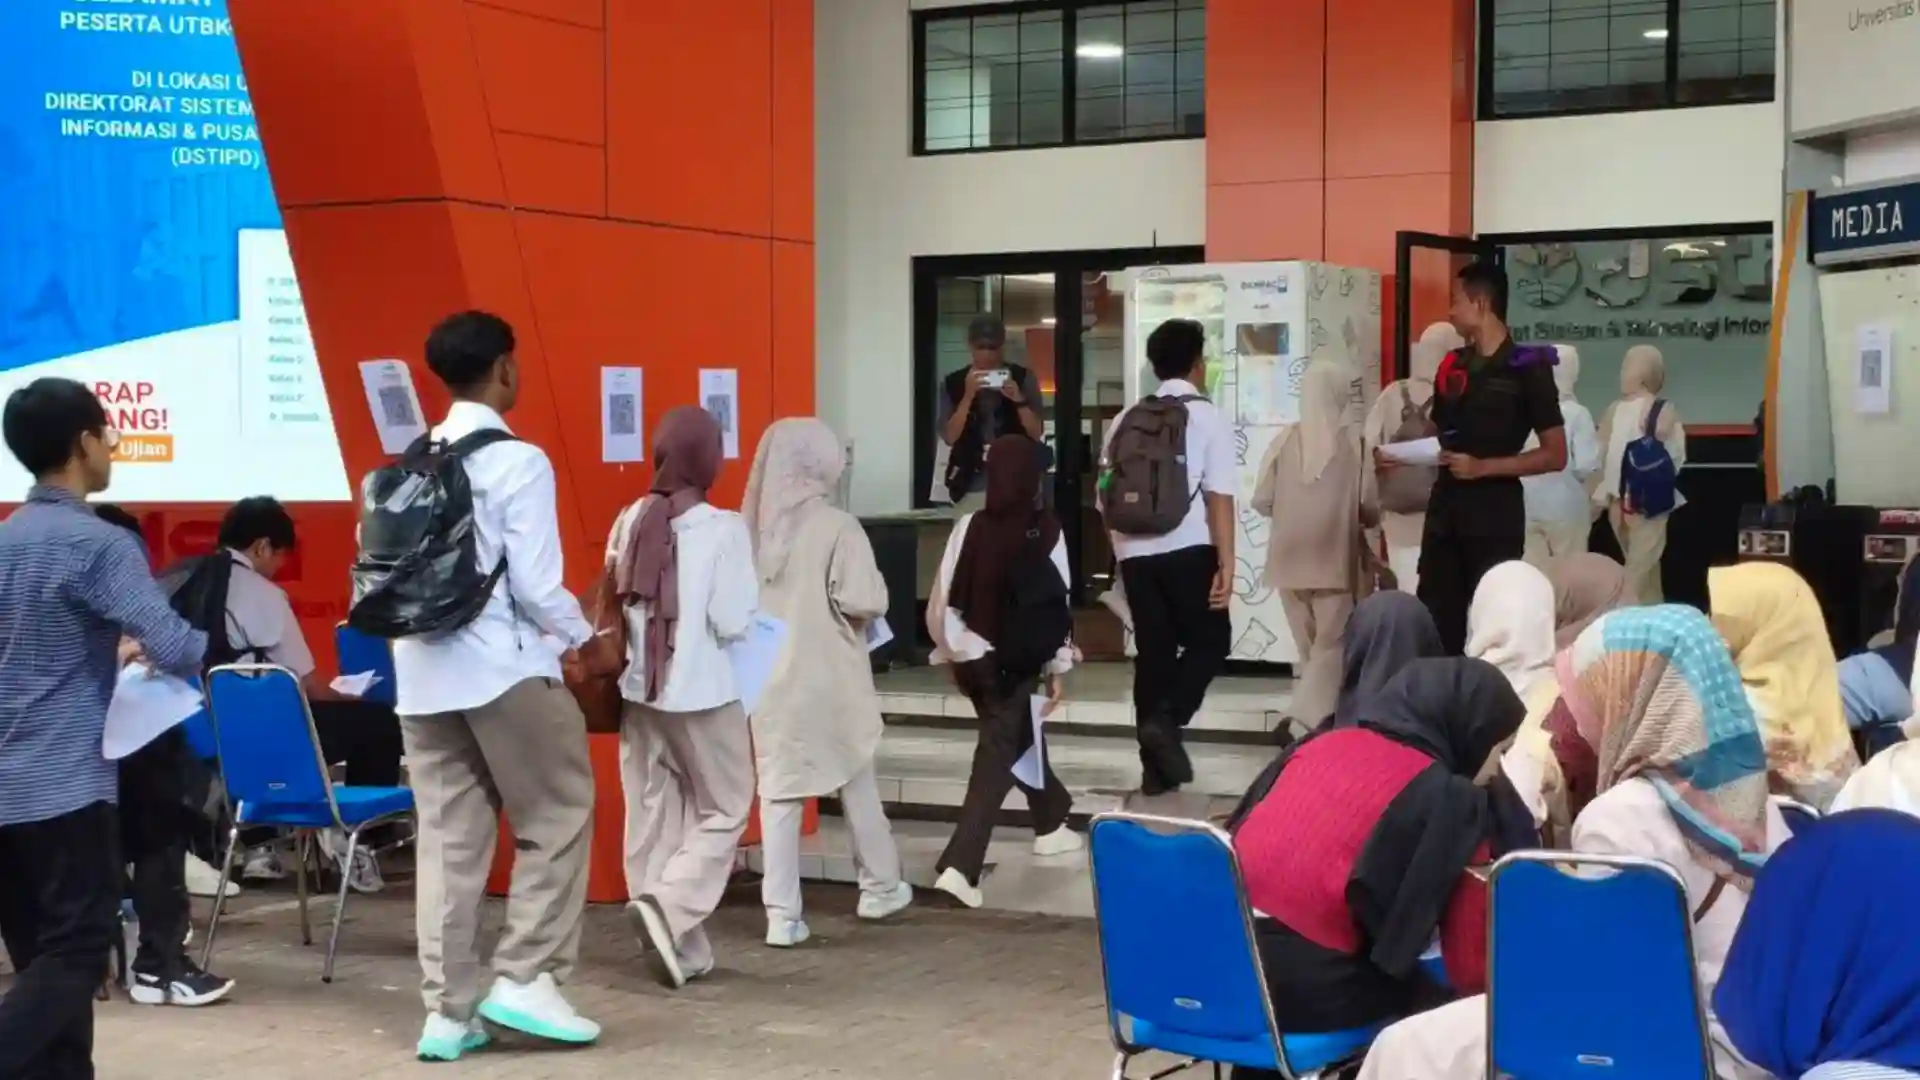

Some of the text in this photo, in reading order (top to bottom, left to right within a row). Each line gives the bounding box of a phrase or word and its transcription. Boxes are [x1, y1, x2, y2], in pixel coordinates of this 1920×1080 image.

[60, 11, 163, 34] PESERTA
[132, 70, 152, 88] DI
[158, 71, 230, 90] LOKASI
[45, 92, 255, 116] DIREKTORAT SISTEM
[61, 118, 178, 138] INFORMASI
[183, 122, 197, 139] &
[171, 147, 260, 170] (DSTIPD)
[1831, 201, 1903, 239] MEDIA
[95, 381, 154, 404] RAP
[119, 440, 168, 461] Ujian
